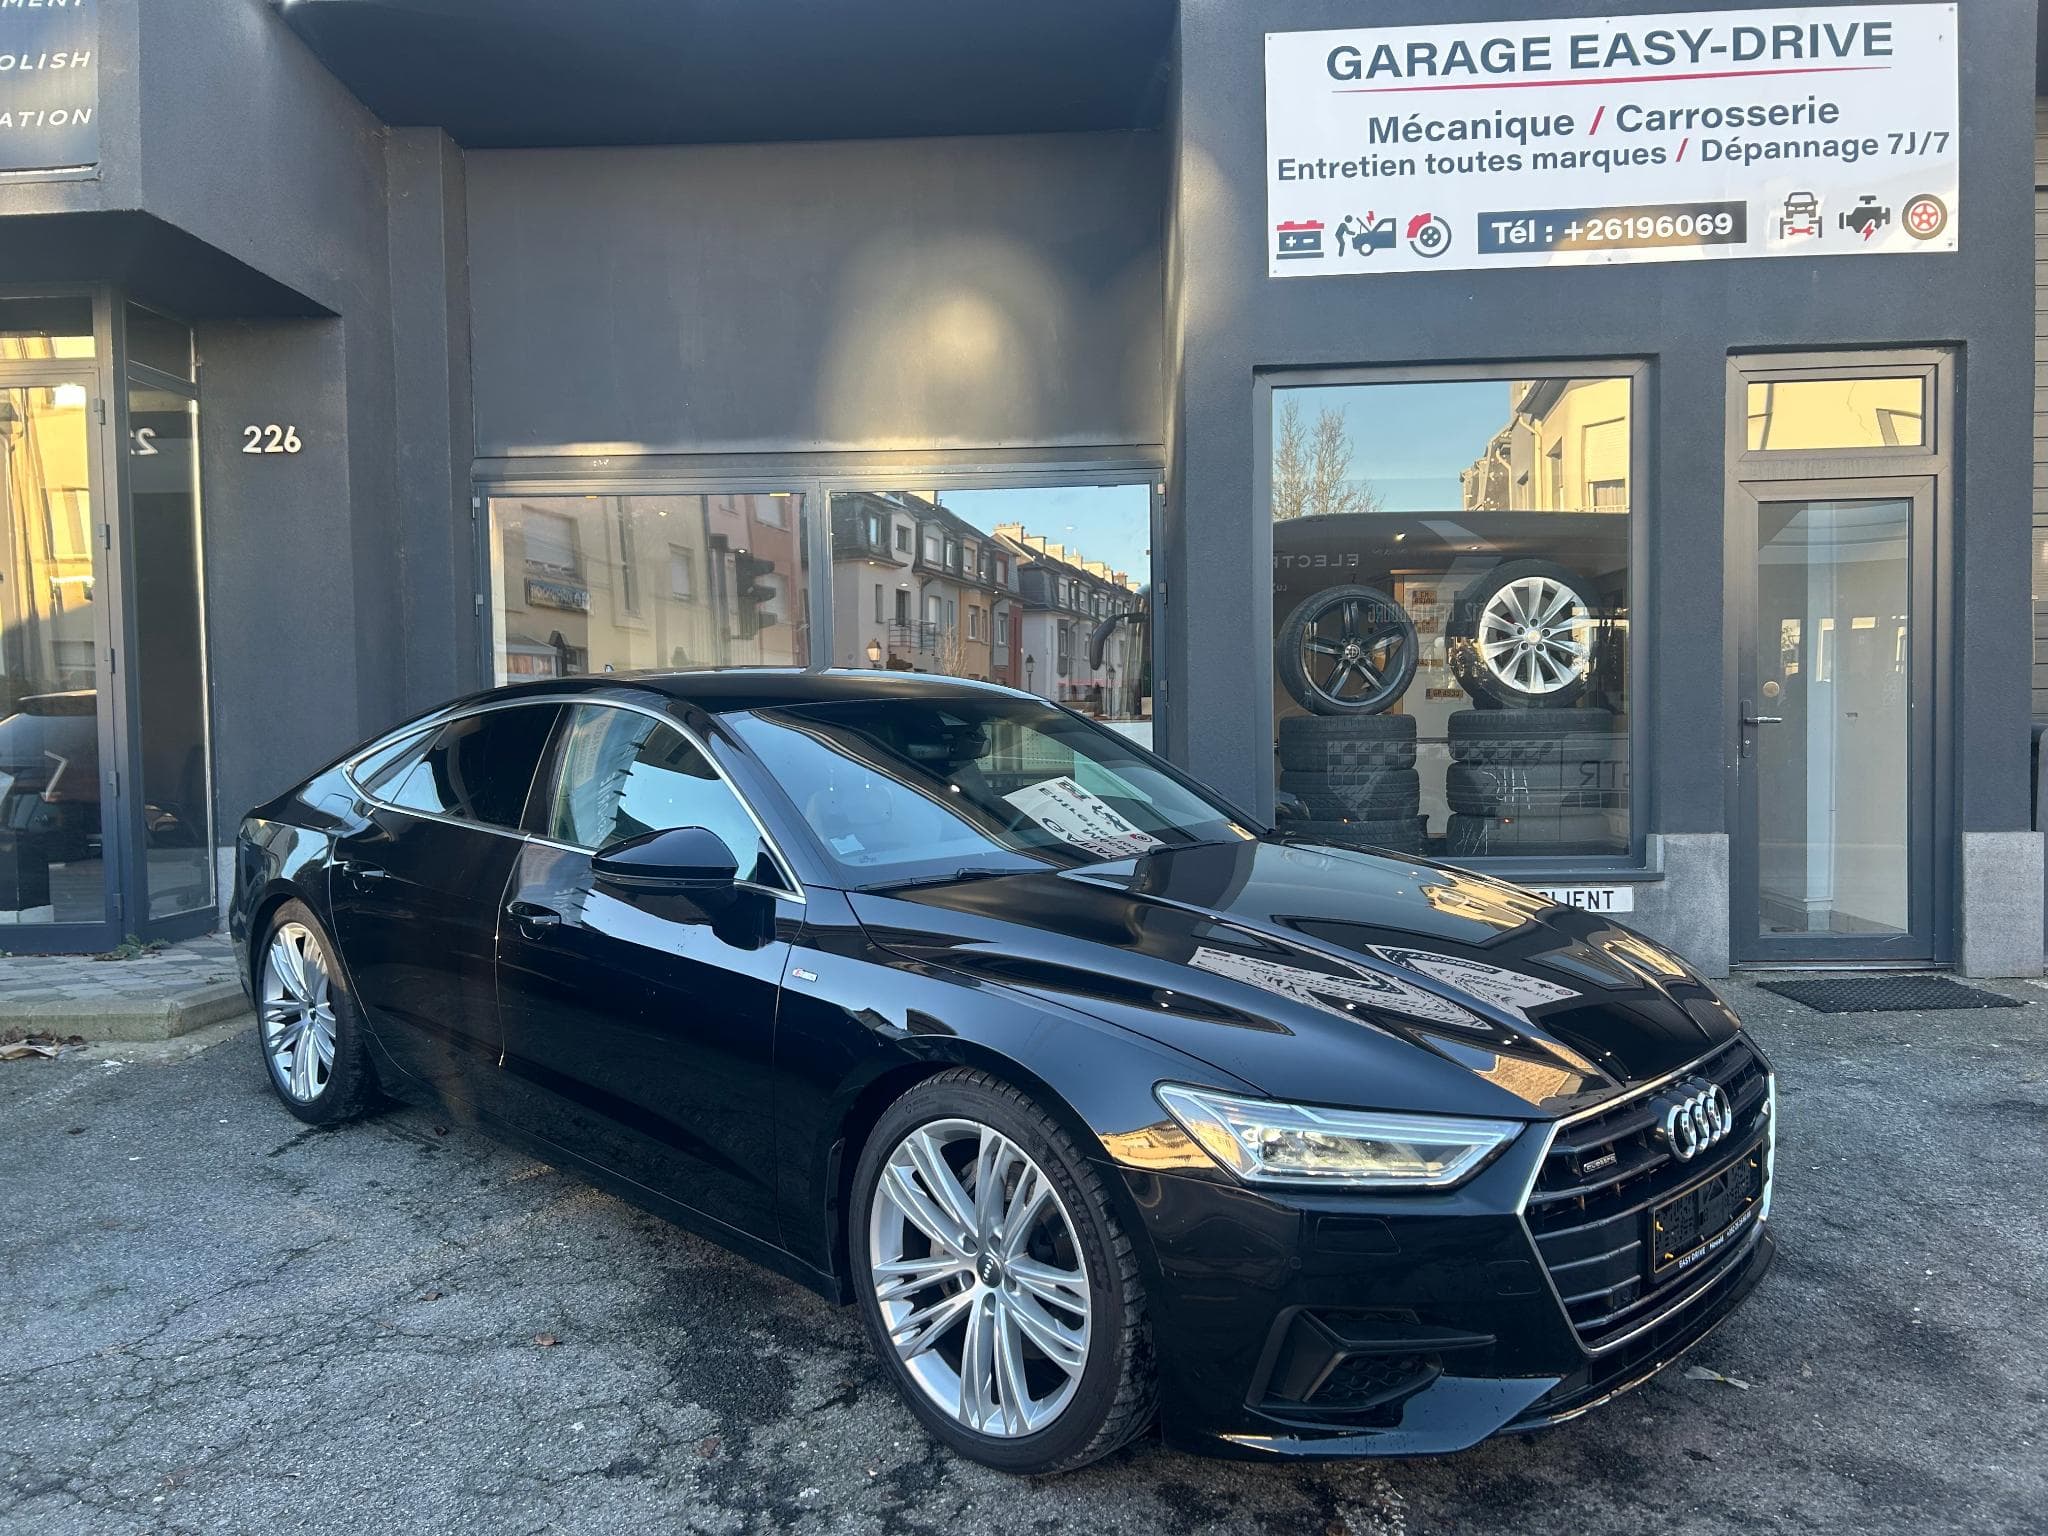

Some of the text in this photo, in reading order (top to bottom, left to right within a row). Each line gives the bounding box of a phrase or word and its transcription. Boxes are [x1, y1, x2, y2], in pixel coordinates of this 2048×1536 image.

[0, 51, 91, 71] OLISH
[1326, 21, 1893, 81] GARAGE EASY-DRIVE
[0, 108, 92, 128] ATION
[1369, 110, 1575, 146] Mécanique
[1616, 96, 1840, 133] Carrosserie
[1278, 153, 1416, 181] Entretien
[1424, 152, 1523, 175] toutes
[1532, 146, 1667, 174] marques
[1701, 136, 1879, 167] Dépannage
[1887, 131, 1950, 156] 7J/7
[1491, 218, 1536, 245] Tél
[1563, 212, 1734, 242] +26196069
[242, 424, 302, 454] 226
